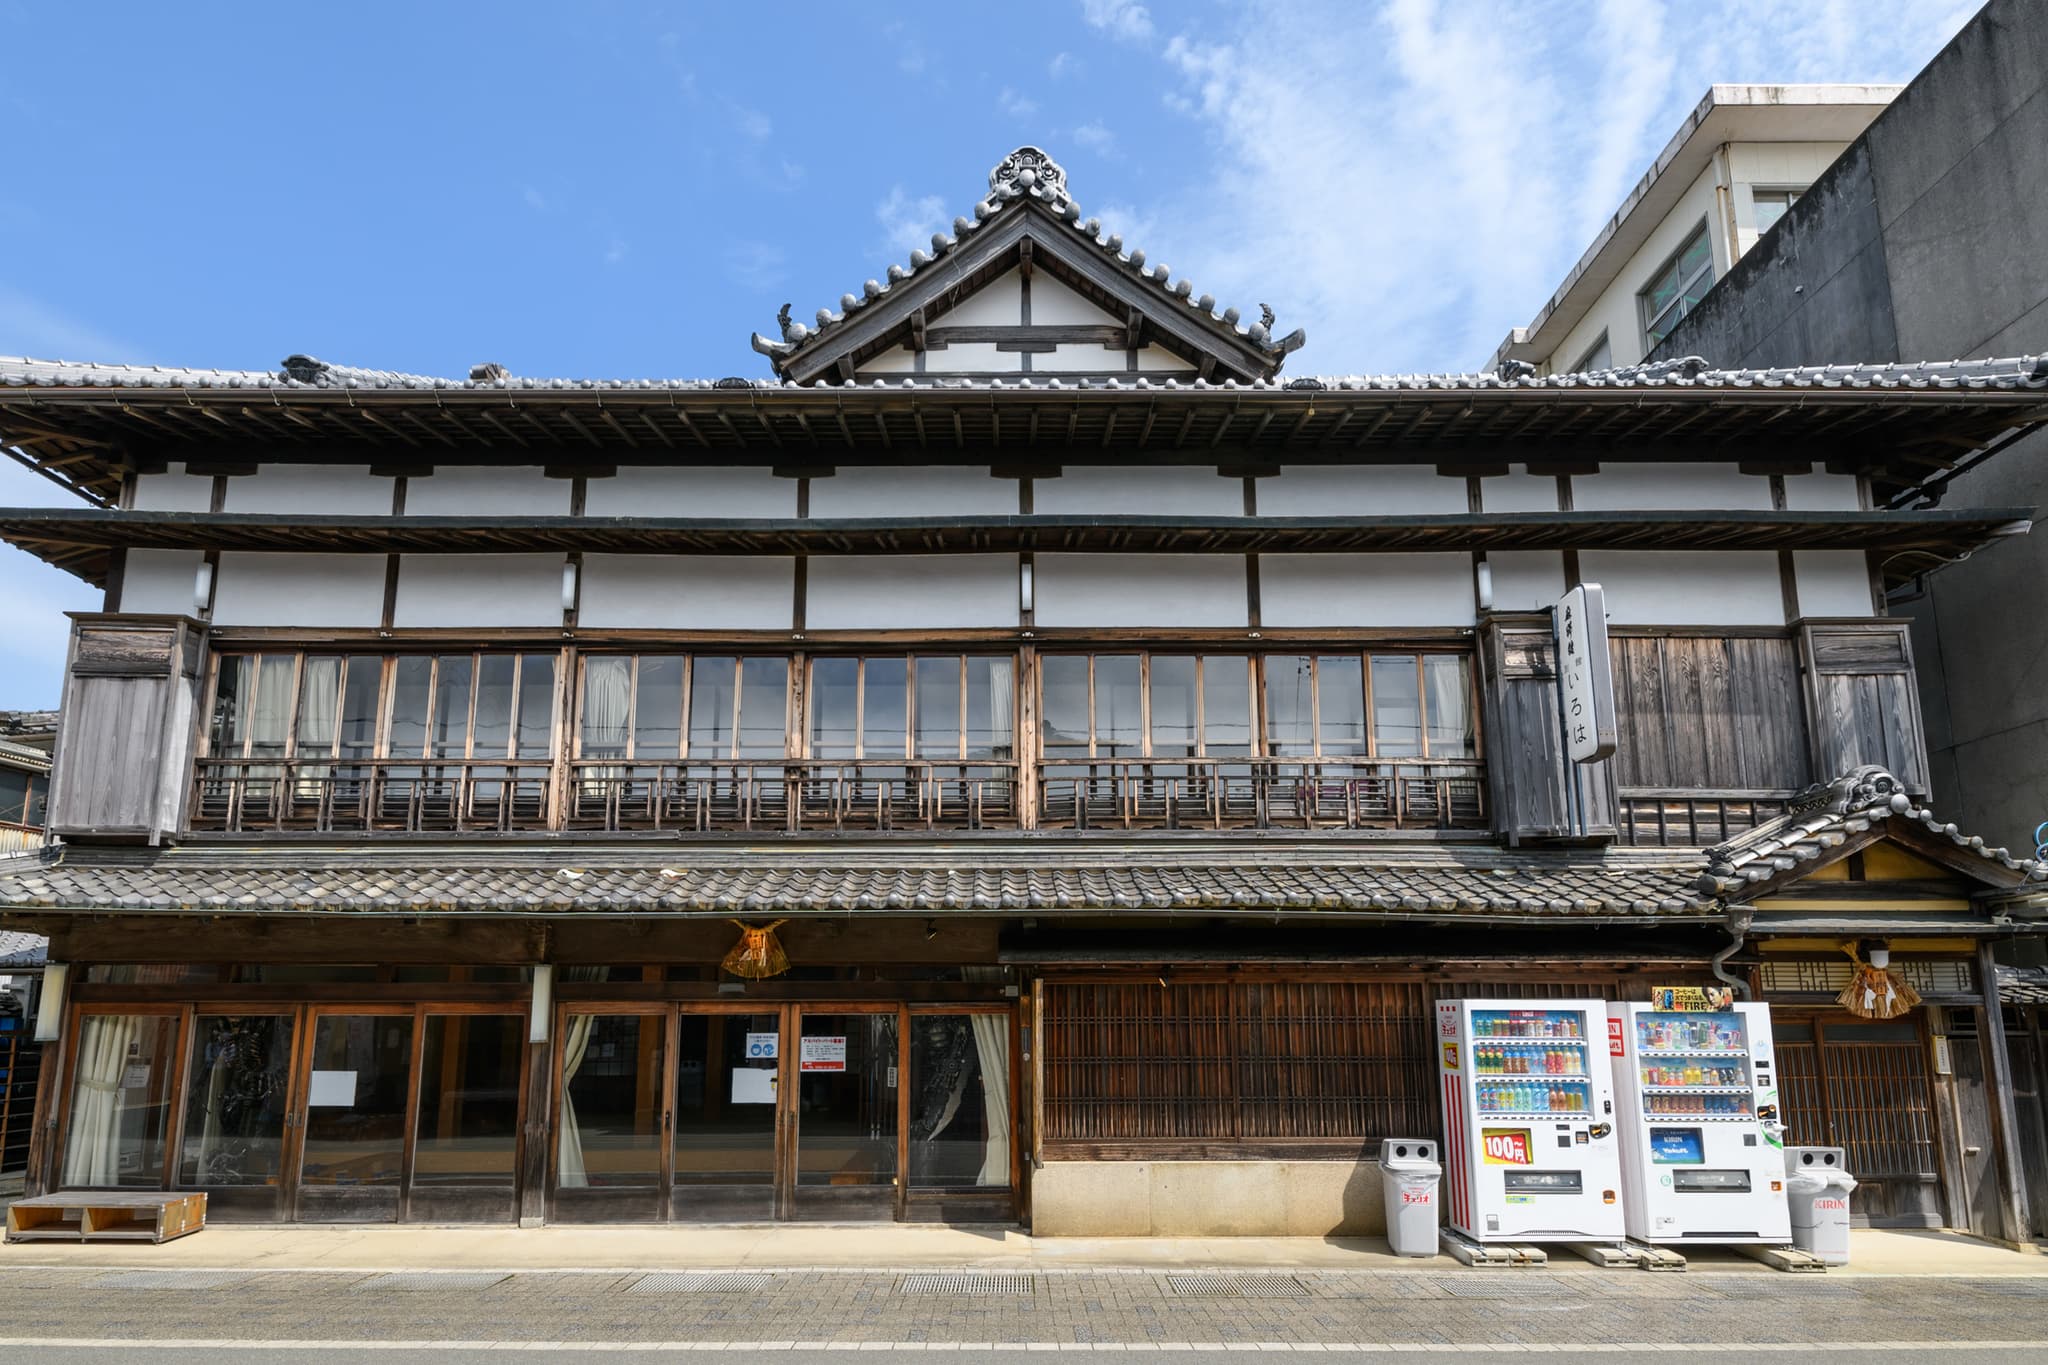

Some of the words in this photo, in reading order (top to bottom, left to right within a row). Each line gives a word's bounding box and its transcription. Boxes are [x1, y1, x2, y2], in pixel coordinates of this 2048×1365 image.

[1567, 672, 1587, 744] いろは
[1815, 1200, 1845, 1209] KIRIN
